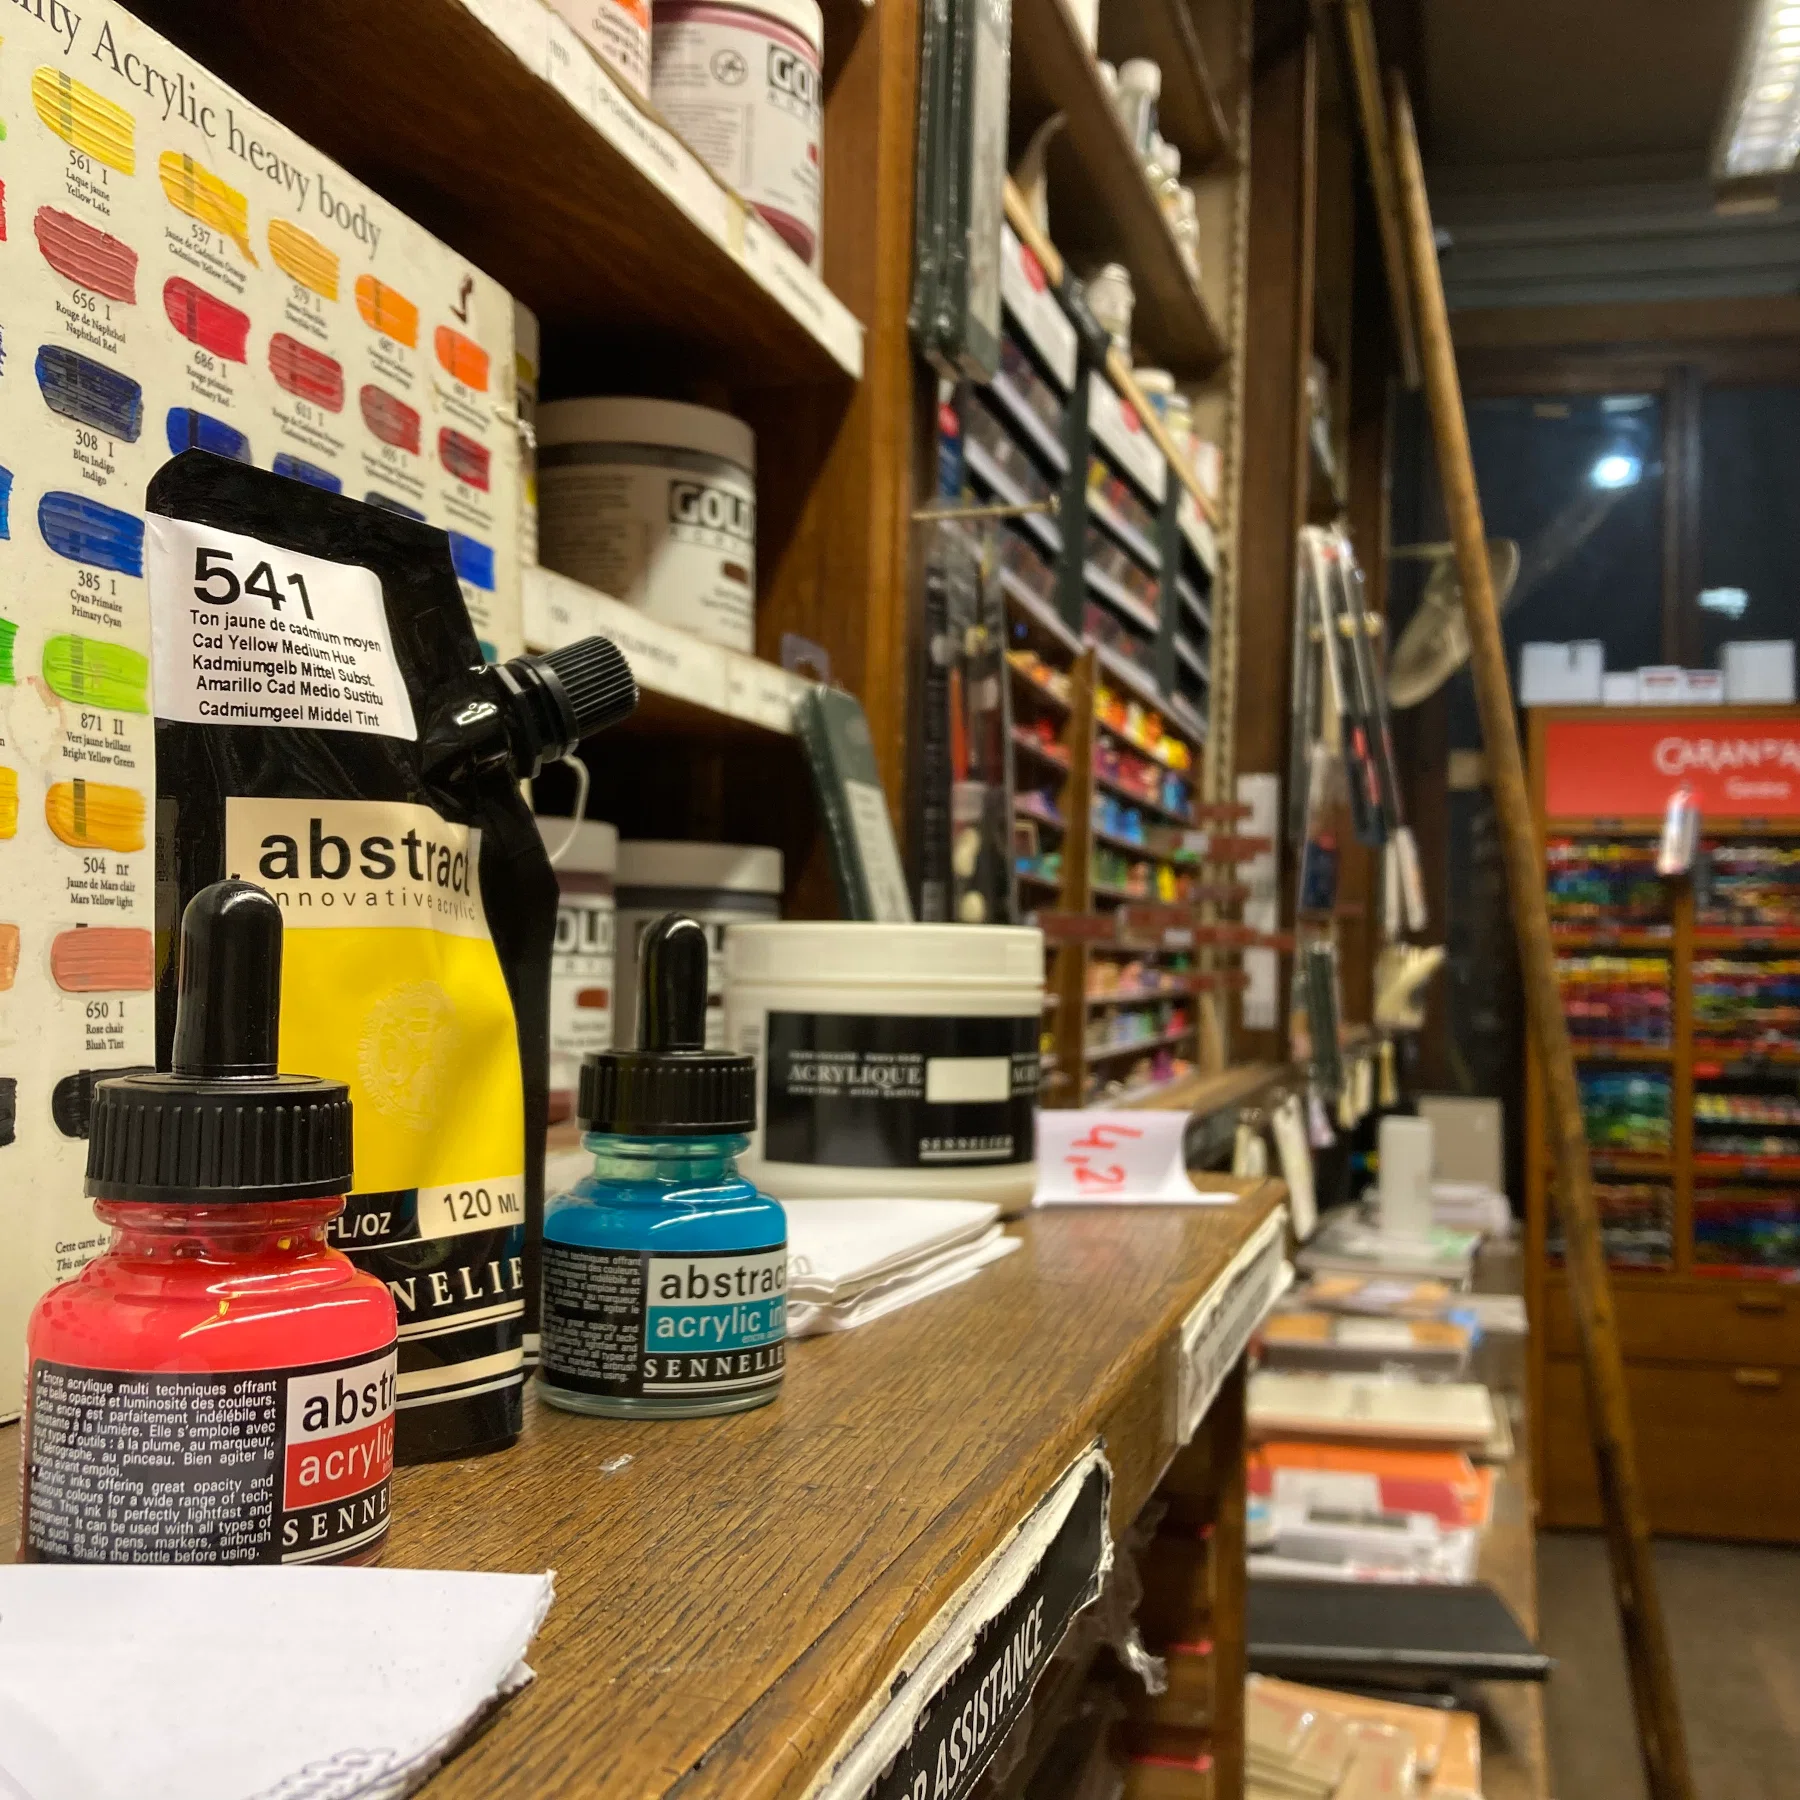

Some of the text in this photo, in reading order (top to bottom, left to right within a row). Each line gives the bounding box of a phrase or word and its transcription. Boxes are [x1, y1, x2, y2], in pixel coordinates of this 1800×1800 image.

[92, 20, 218, 138] Acrylic
[226, 111, 311, 212] heavy
[318, 172, 383, 260] body
[69, 149, 91, 174] 561
[66, 182, 110, 216] Yellow Lake
[191, 224, 211, 245] 537
[73, 289, 96, 312] 656
[56, 300, 127, 343] Rouge Naphthol
[66, 321, 117, 354] Naphthol Red
[194, 350, 214, 371] 686
[75, 428, 98, 451] 308
[73, 448, 115, 475] Bleu Indigo
[82, 467, 107, 487] Indigo
[78, 570, 101, 591] 385
[194, 546, 315, 621] 541
[70, 589, 90, 604] Cyan
[72, 604, 122, 628] Primary Cyan
[190, 609, 381, 653] Ton jaune de cadmium moyen
[192, 633, 356, 666] Cad Yellow Medium Hue
[192, 654, 375, 688] Kadmiumgelb Mittel Subst.
[196, 675, 384, 706] Amarillo Cad Medio Sustitu
[81, 712, 102, 731] 871
[198, 700, 380, 727] Cadmiumgeel Middel Tint
[66, 731, 83, 744] Vert
[62, 746, 136, 768] Bright Yellow Green
[83, 857, 107, 874] 504
[259, 818, 471, 897] abstract
[66, 877, 136, 892] Jaune Mars clair
[70, 893, 133, 910] Mars Yellow light
[274, 887, 433, 909] nnovative
[86, 1000, 109, 1019] 650
[86, 1022, 123, 1035] Rose chair
[86, 1038, 124, 1050] Blush Tint
[787, 1064, 922, 1089] ACRYLIQUE
[444, 1188, 520, 1222] 120 ML
[325, 1212, 391, 1239] FL/OZ
[55, 1238, 96, 1254] Cette carte
[56, 1259, 73, 1272] This
[660, 1264, 786, 1299] abstrac
[656, 1305, 761, 1343] acrylic
[43, 1370, 277, 1397] Encre acrylique multi techniques offrant
[68, 1393, 276, 1410] opacité et luminosité des couleurs.
[56, 1404, 81, 1418] encre
[86, 1408, 103, 1420] est
[110, 1410, 188, 1424] parfaitement
[196, 1408, 257, 1423] indélébile
[263, 1407, 276, 1419] et
[83, 1420, 93, 1433] la
[97, 1421, 143, 1437] lumière.
[149, 1424, 172, 1437] Elle
[246, 1422, 276, 1435] avec
[128, 1437, 275, 1453] la plume, au marqueur,
[299, 1422, 393, 1487] acrylic
[55, 1458, 80, 1472] avant
[102, 1447, 275, 1466] au pinceau. Bien agiter le
[70, 1474, 274, 1496] inks offering great opacity and
[65, 1488, 104, 1503] colours
[108, 1491, 125, 1505] for
[143, 1494, 173, 1507] wide
[179, 1496, 216, 1509] range
[221, 1493, 235, 1504] of
[60, 1499, 80, 1515] This
[84, 1503, 101, 1517] ink
[107, 1505, 118, 1519] is
[124, 1507, 180, 1523] perfectly
[188, 1507, 242, 1523] lightfast
[249, 1501, 273, 1516] and
[86, 1515, 272, 1535] can be used with all types of
[48, 1527, 271, 1551] such as dip pens, markers, airbrush
[73, 1543, 260, 1563] Shake the bottle before using.
[934, 1595, 1044, 1800] ASSISTANCE
